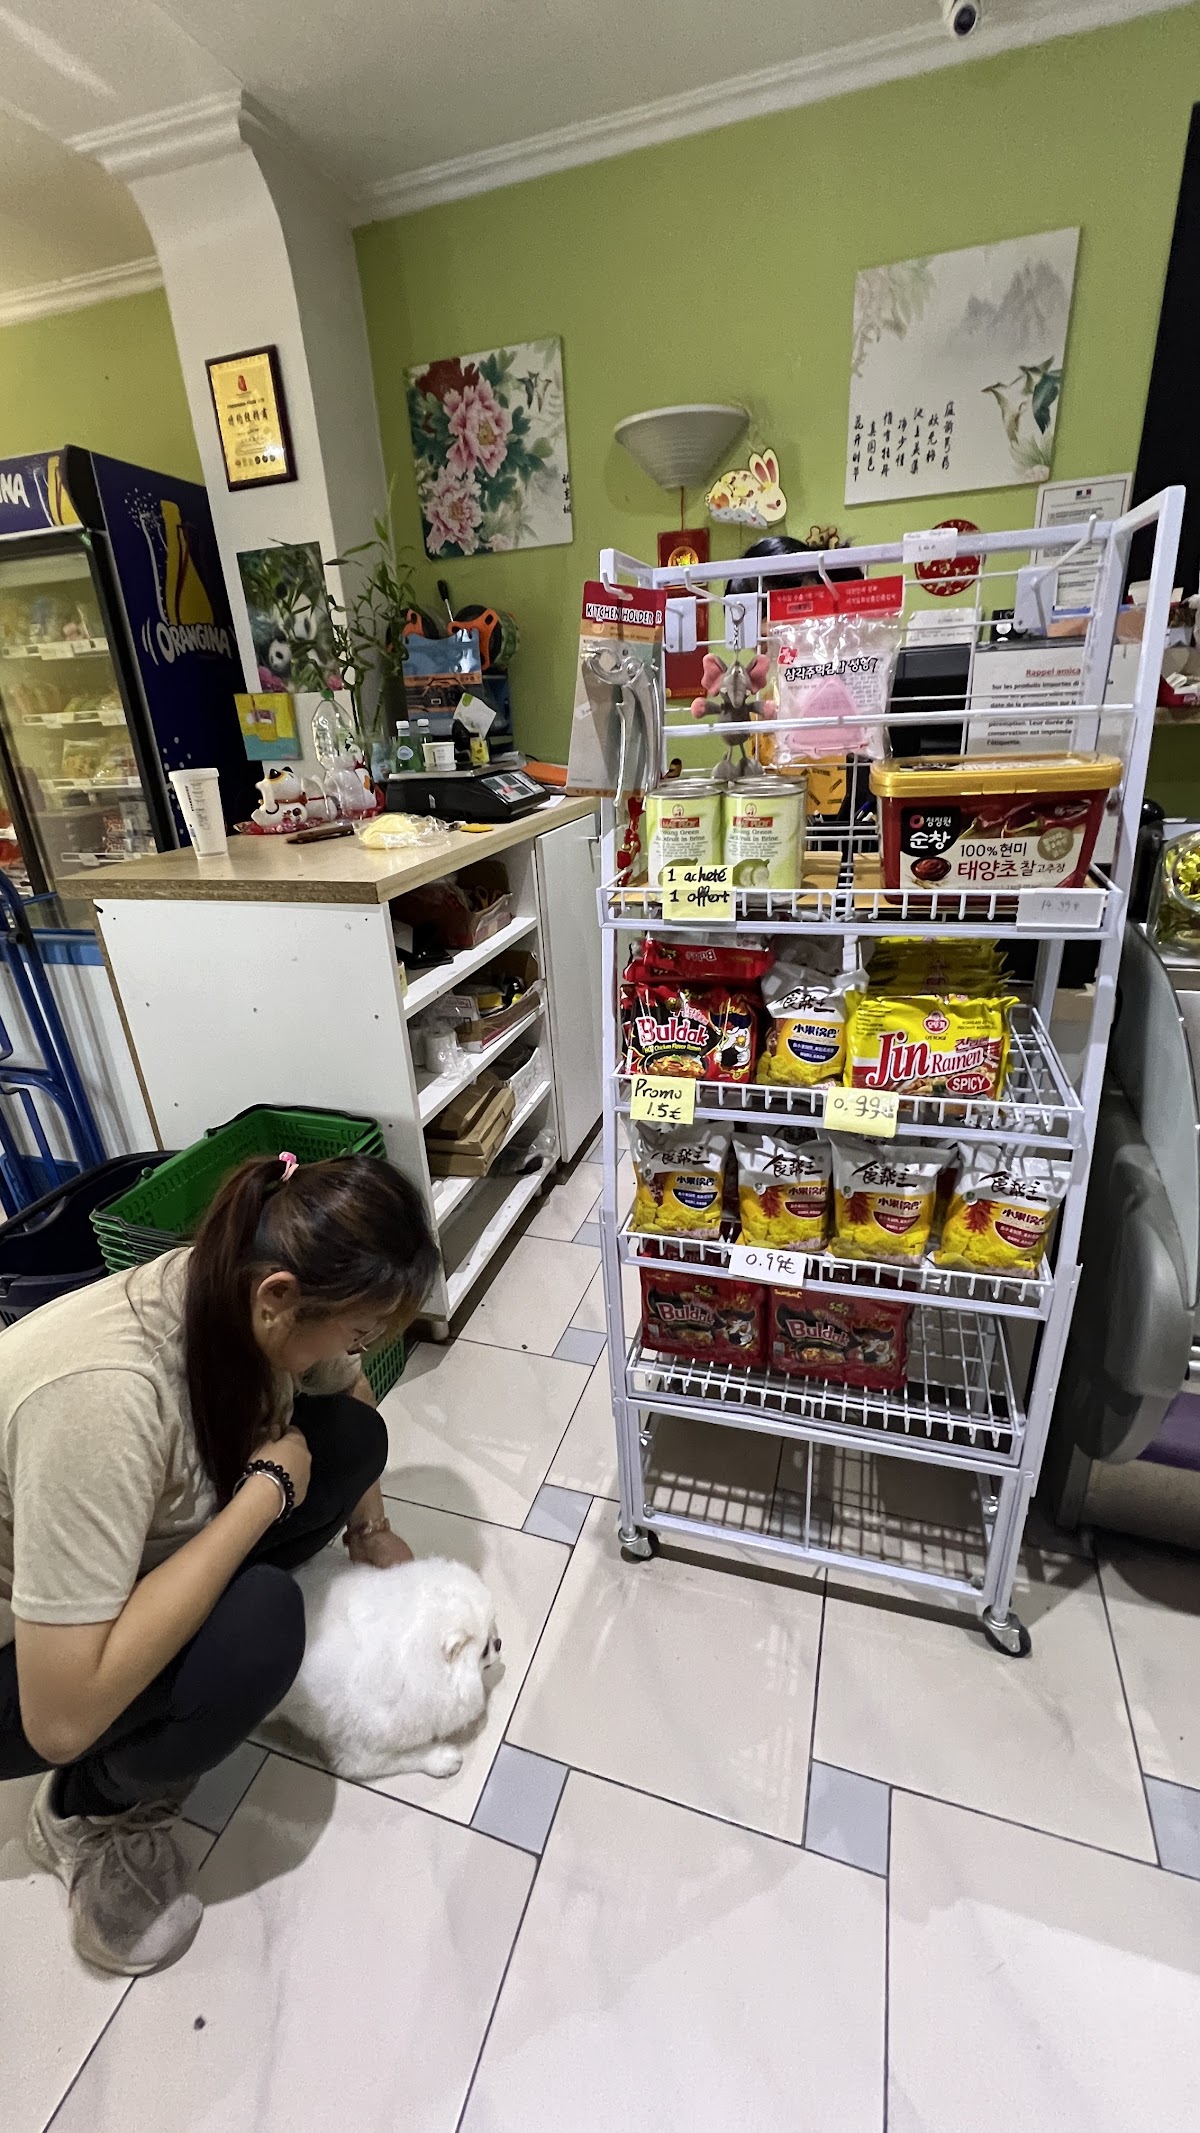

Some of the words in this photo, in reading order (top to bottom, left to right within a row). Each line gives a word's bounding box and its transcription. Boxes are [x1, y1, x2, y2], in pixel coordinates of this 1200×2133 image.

[587, 604, 621, 621] KITCHEN
[622, 609, 654, 624] HOLDER
[156, 621, 233, 664] ORANGINA
[1026, 668, 1055, 678] Rappel
[909, 829, 952, 851] 순창
[667, 868, 677, 882] 1
[684, 866, 728, 883] acheté
[957, 860, 1019, 881] 태양초
[670, 889, 680, 903] 1
[687, 885, 730, 907] offert
[635, 1015, 709, 1048] Buldak
[866, 1031, 932, 1088] Jin
[932, 1049, 984, 1073] Ramen
[635, 1078, 683, 1099] Promo
[952, 1076, 985, 1091] SPICY
[646, 1101, 682, 1120] 1.5€
[656, 1301, 716, 1327] Buldak
[786, 1318, 851, 1347] Buldak
